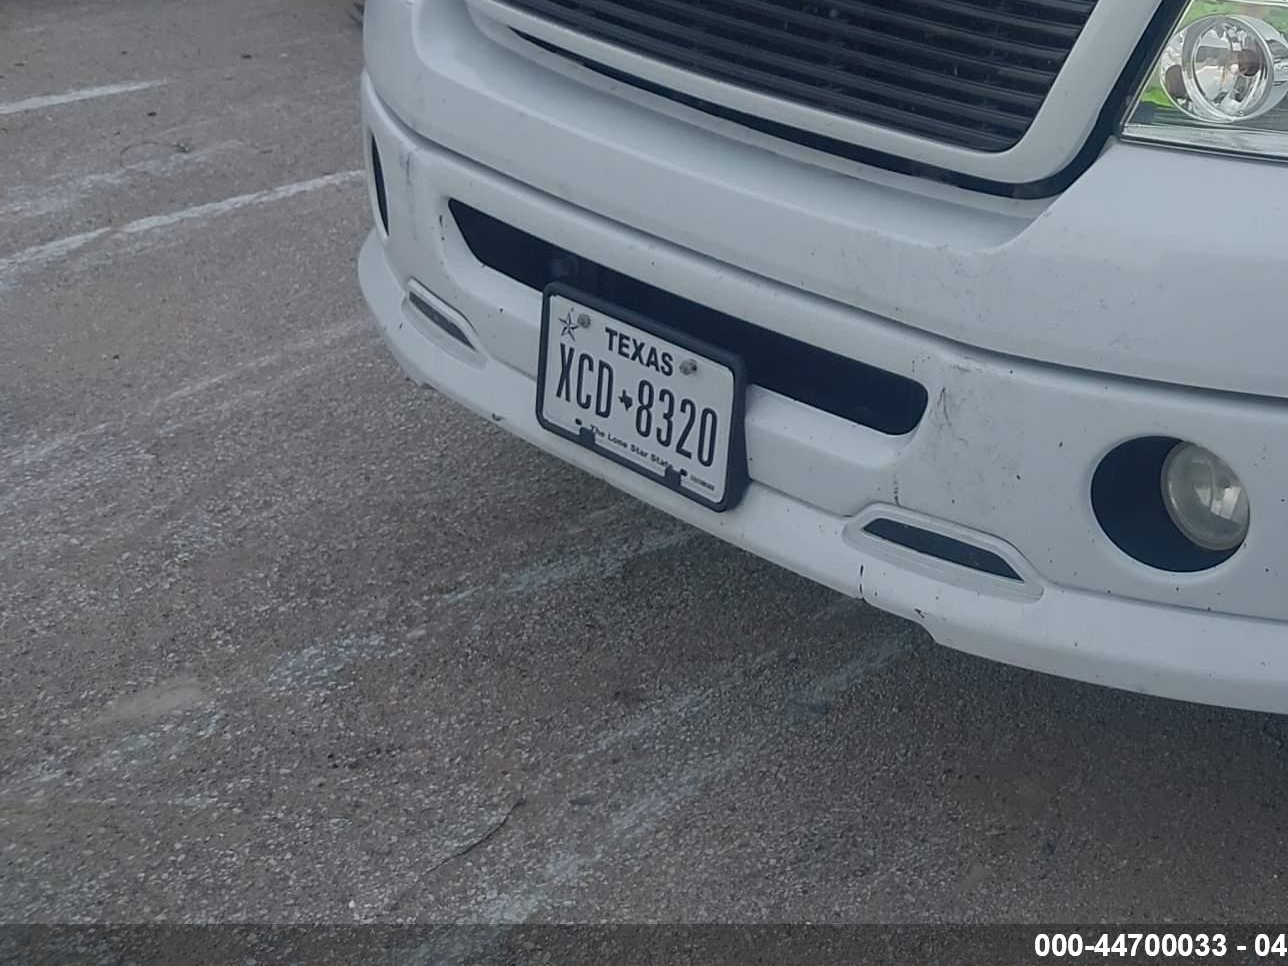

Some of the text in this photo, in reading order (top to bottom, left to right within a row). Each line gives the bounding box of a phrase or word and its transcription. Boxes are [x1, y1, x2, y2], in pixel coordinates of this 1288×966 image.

[605, 327, 673, 376] TEXAS
[590, 424, 605, 438] The
[608, 433, 628, 448] Lone
[630, 444, 649, 458] Star
